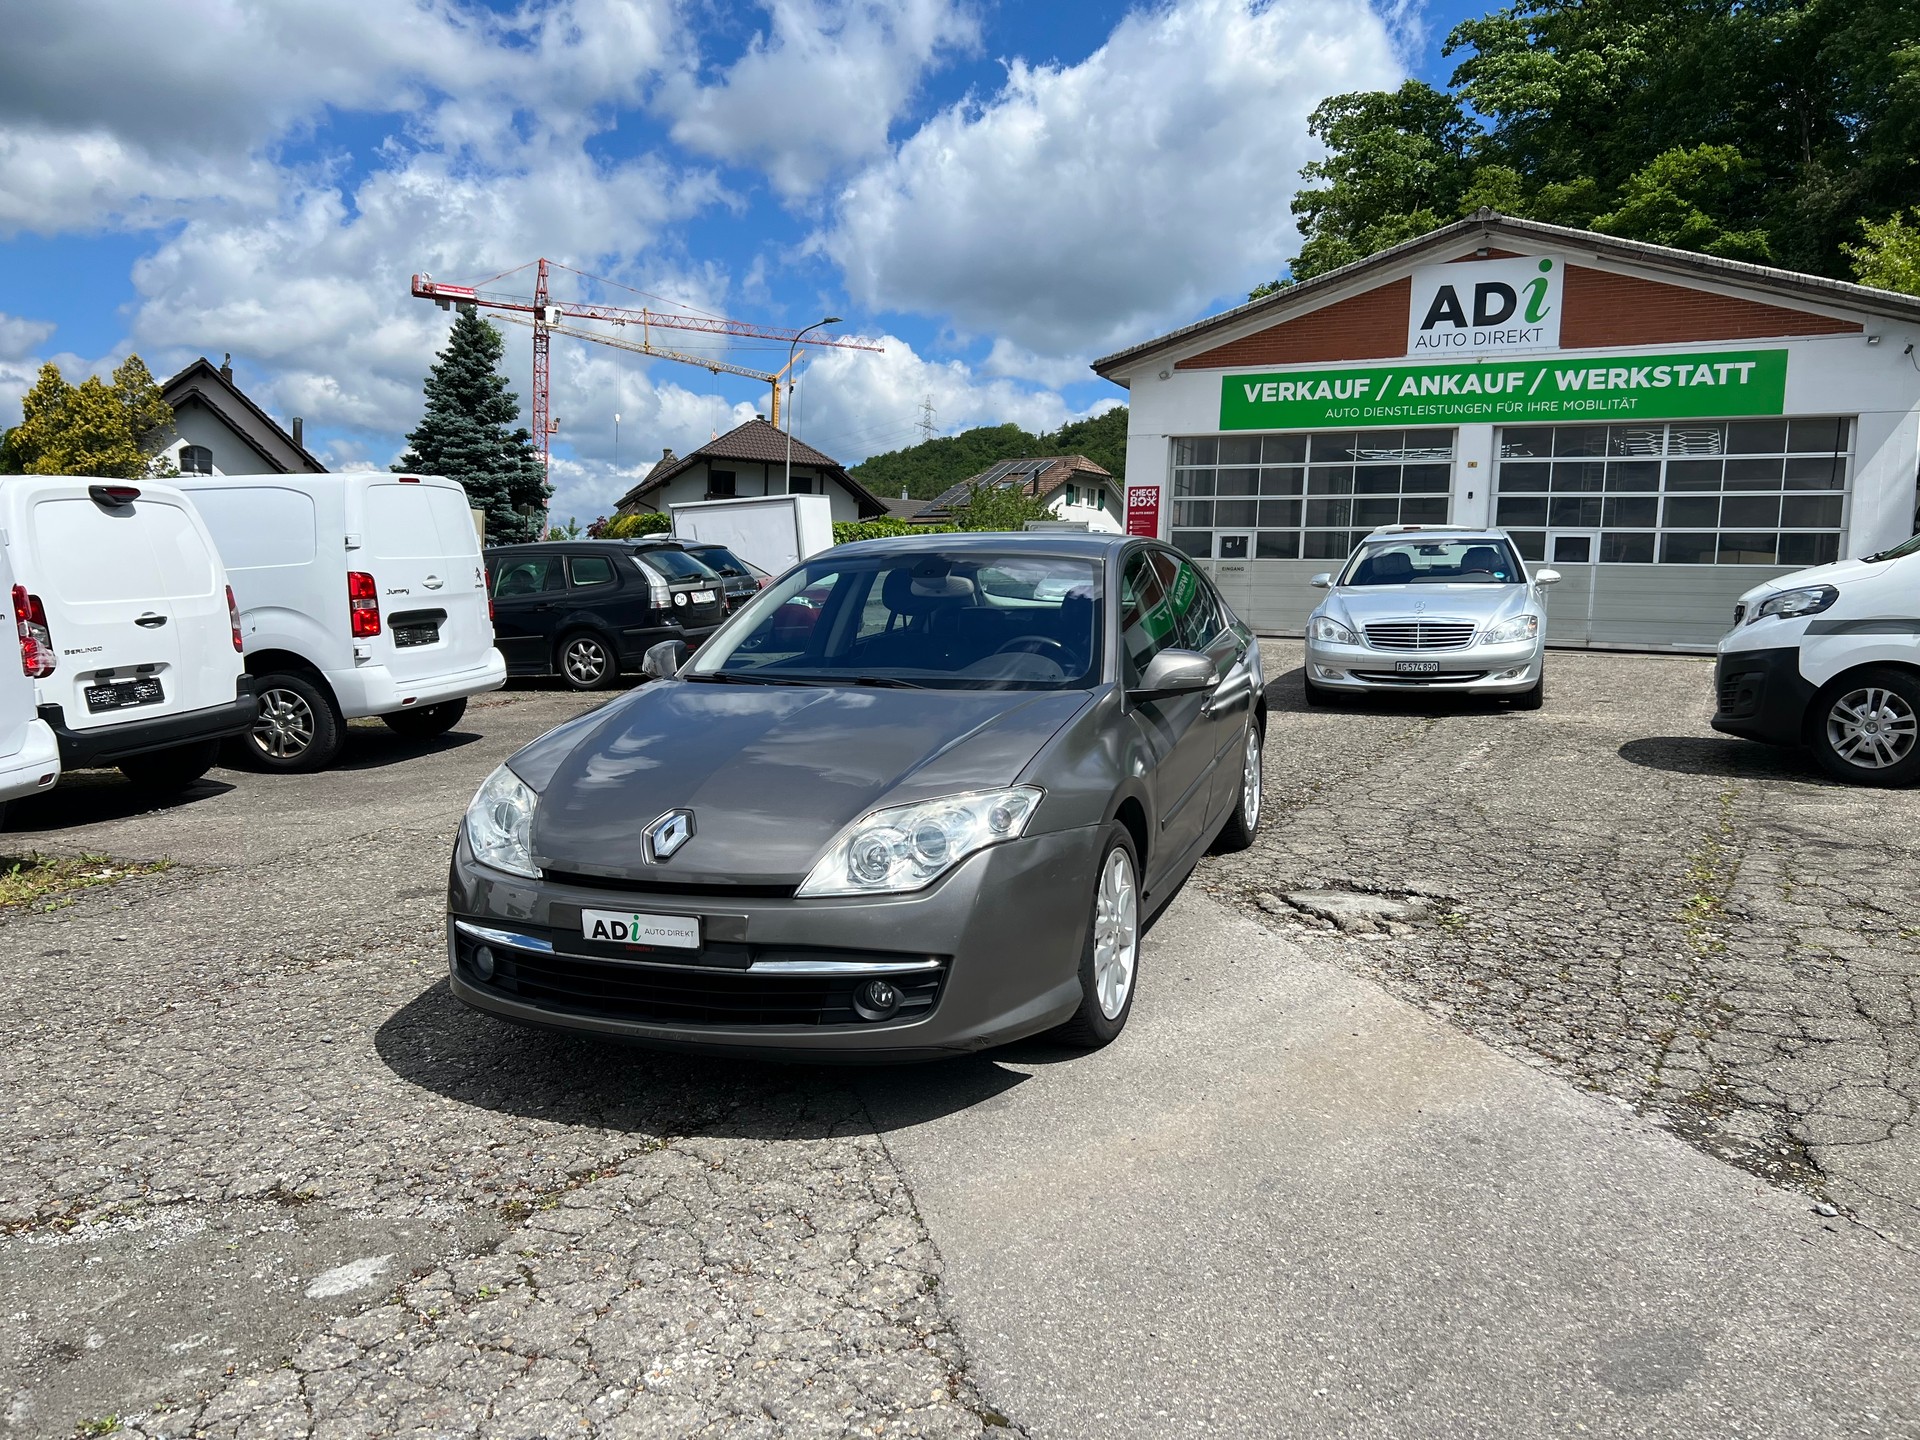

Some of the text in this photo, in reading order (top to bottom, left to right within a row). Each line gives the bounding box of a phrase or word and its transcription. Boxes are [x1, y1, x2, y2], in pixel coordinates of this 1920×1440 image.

[1420, 259, 1553, 330] ADi
[1415, 328, 1543, 348] AUTO DIREKT
[1243, 378, 1371, 403] VERKAUF
[1398, 372, 1525, 397] ANKAUF
[1554, 362, 1756, 392] WERKSTATT
[1325, 397, 1639, 419] AUTO DIENSTLEISTUNGEN FÜR IHRE MOBILITÄT
[1130, 488, 1157, 497] CHECK
[1397, 663, 1407, 671] AG
[592, 914, 695, 942] ADi AUTO DIREKT
